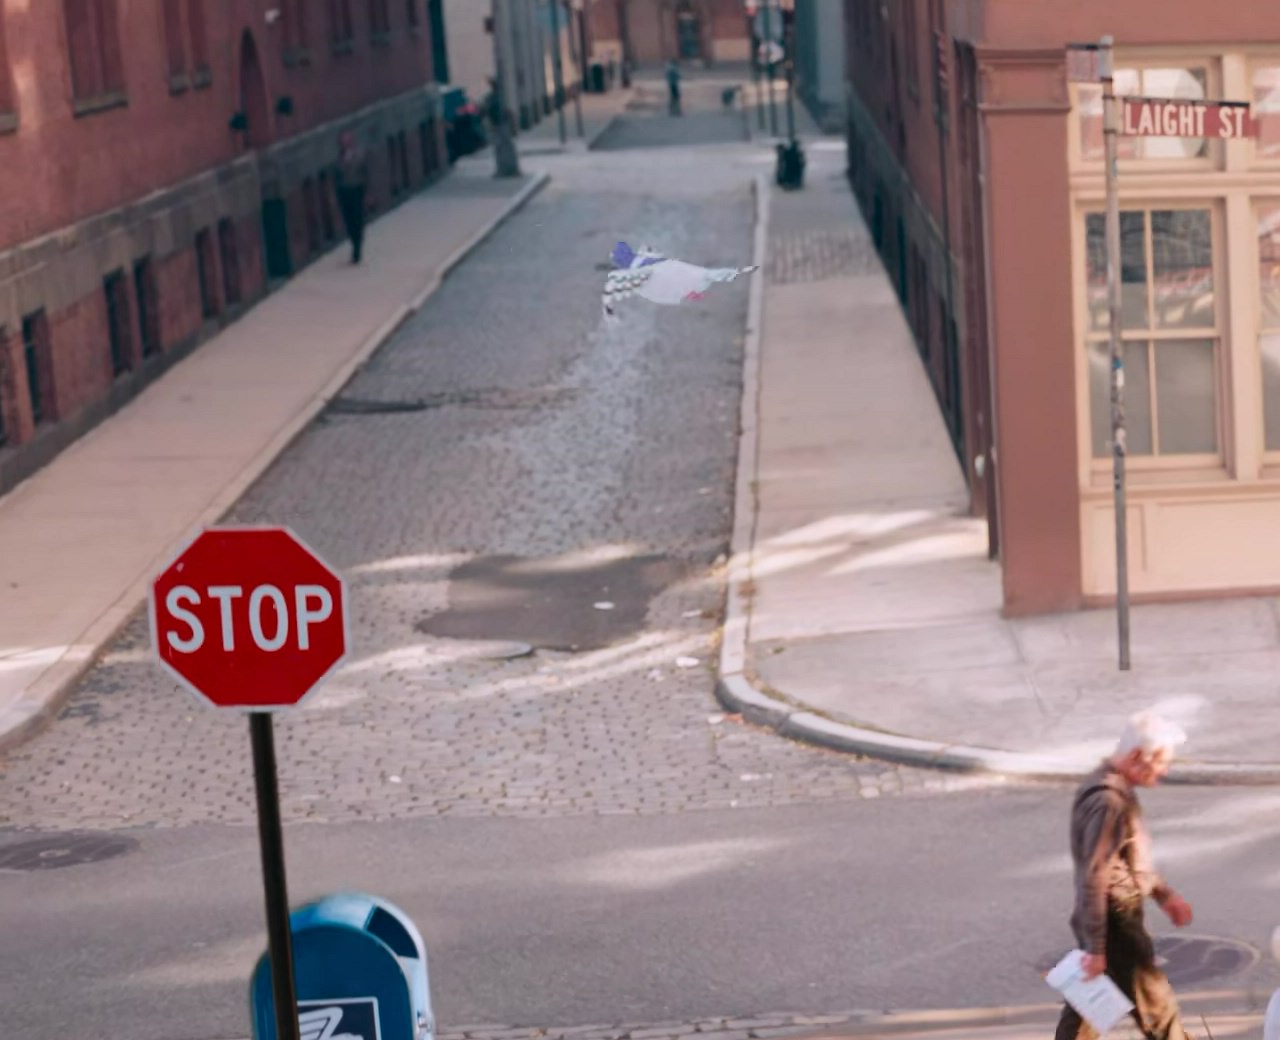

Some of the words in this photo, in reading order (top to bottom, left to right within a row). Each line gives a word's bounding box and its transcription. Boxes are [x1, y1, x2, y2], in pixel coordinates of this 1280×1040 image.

[1124, 103, 1207, 135] LAIGHT
[1218, 106, 1247, 138] ST
[166, 584, 334, 653] STOP
